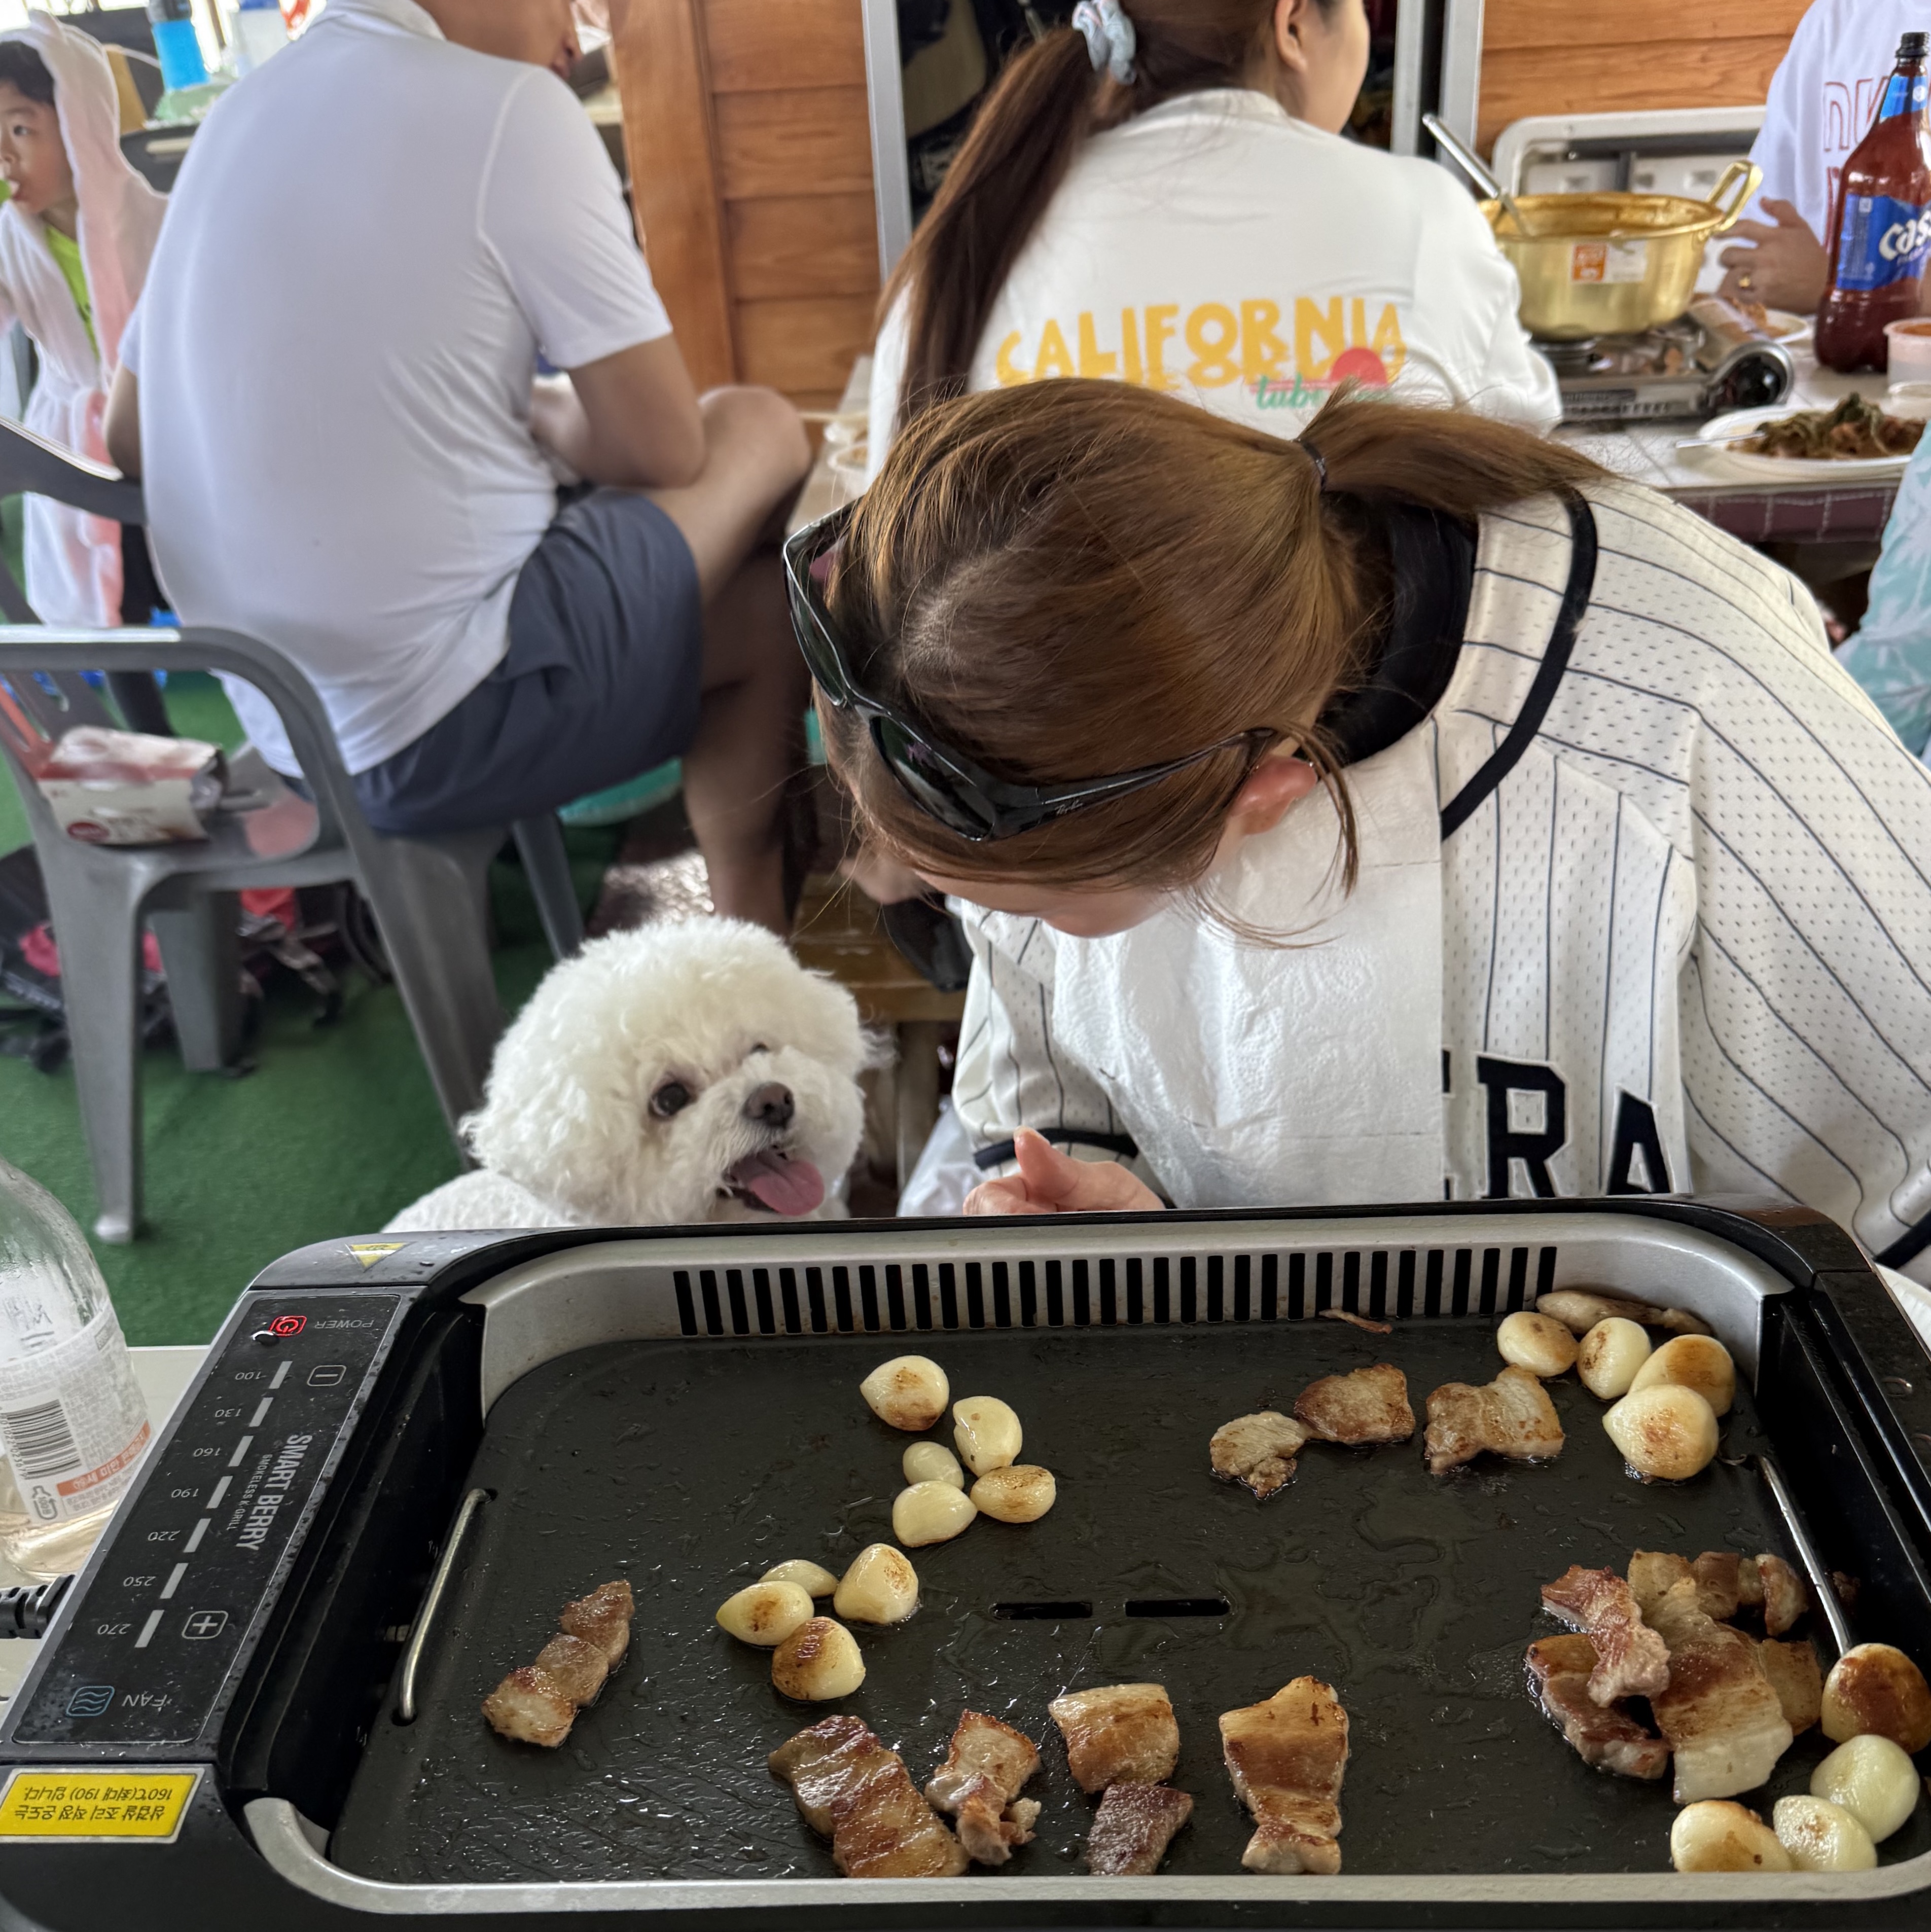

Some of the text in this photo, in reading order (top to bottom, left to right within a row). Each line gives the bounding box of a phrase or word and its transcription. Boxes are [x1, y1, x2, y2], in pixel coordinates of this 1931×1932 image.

[1879, 210, 1931, 262] Cas
[995, 297, 1408, 391] CALIFORNIA
[1442, 1047, 1672, 1200] RA
[314, 1319, 374, 1329] POWER
[235, 1371, 261, 1380] 100
[214, 1408, 242, 1418] 130
[193, 1447, 221, 1457] 160
[171, 1488, 199, 1498] 190
[236, 1435, 313, 1551] SMART BERRY
[147, 1530, 181, 1541] 220
[123, 1576, 156, 1587] 250
[97, 1623, 129, 1635] 270
[122, 1694, 169, 1708] FAN
[24, 1786, 67, 1801] 입니다.
[15, 1804, 165, 1821] 삼겹살 조리 적정 온도는
